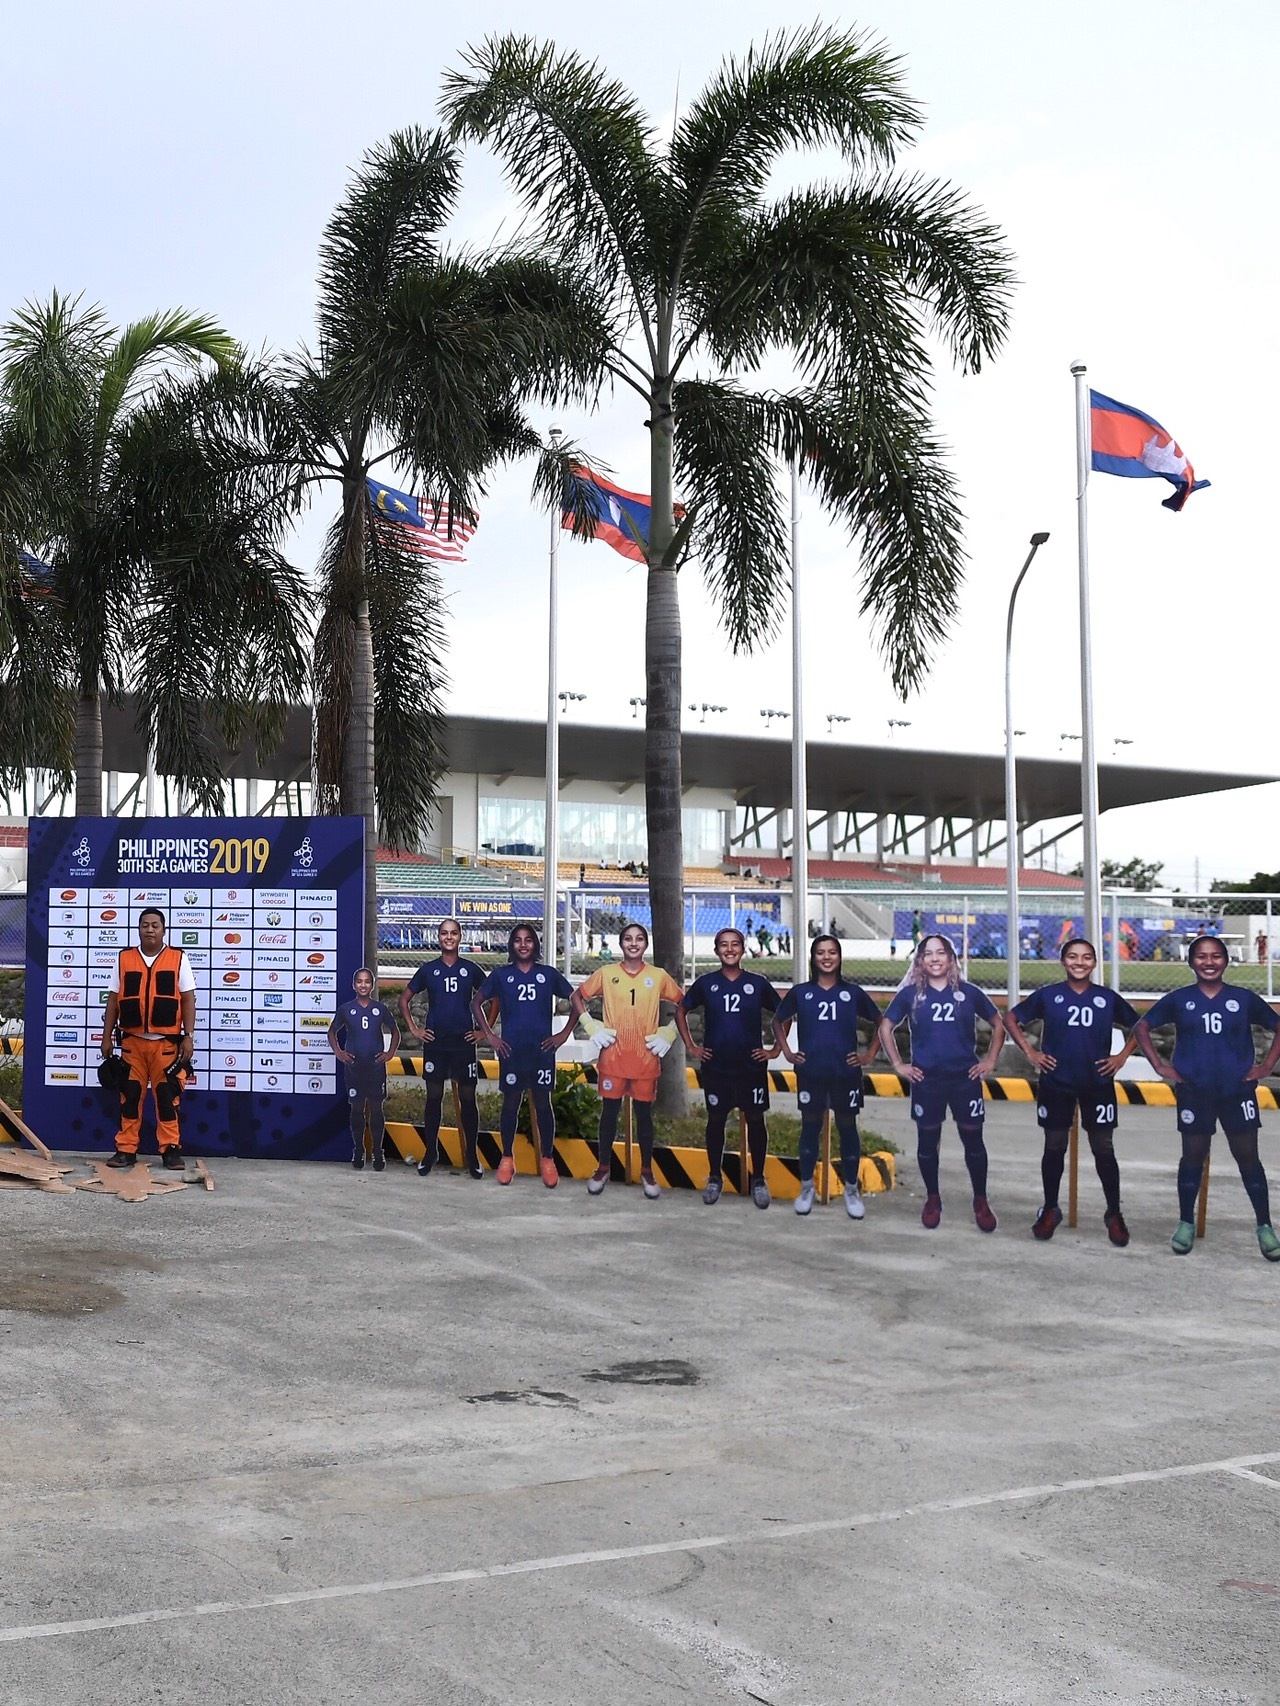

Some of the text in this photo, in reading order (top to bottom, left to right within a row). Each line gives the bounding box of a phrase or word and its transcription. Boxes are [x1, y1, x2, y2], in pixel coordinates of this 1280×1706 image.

[118, 837, 270, 874] PHILIPPINES 2019
[117, 859, 209, 874] 30TH SEA GAMES
[460, 902, 512, 913] WE WIN AS ONE
[444, 976, 458, 993] 15
[517, 983, 537, 1001] 25
[629, 988, 636, 1006] 1
[723, 993, 741, 1012] 12
[818, 1001, 837, 1021] 21
[931, 1002, 955, 1022] 22
[1067, 1005, 1093, 1027] 20
[361, 1016, 369, 1029] 6
[1202, 1012, 1223, 1034] 16
[538, 1069, 552, 1085] 25
[752, 1087, 764, 1105] 12
[969, 1100, 984, 1118] 22
[1096, 1104, 1114, 1124] 20
[1241, 1100, 1256, 1121] 16
